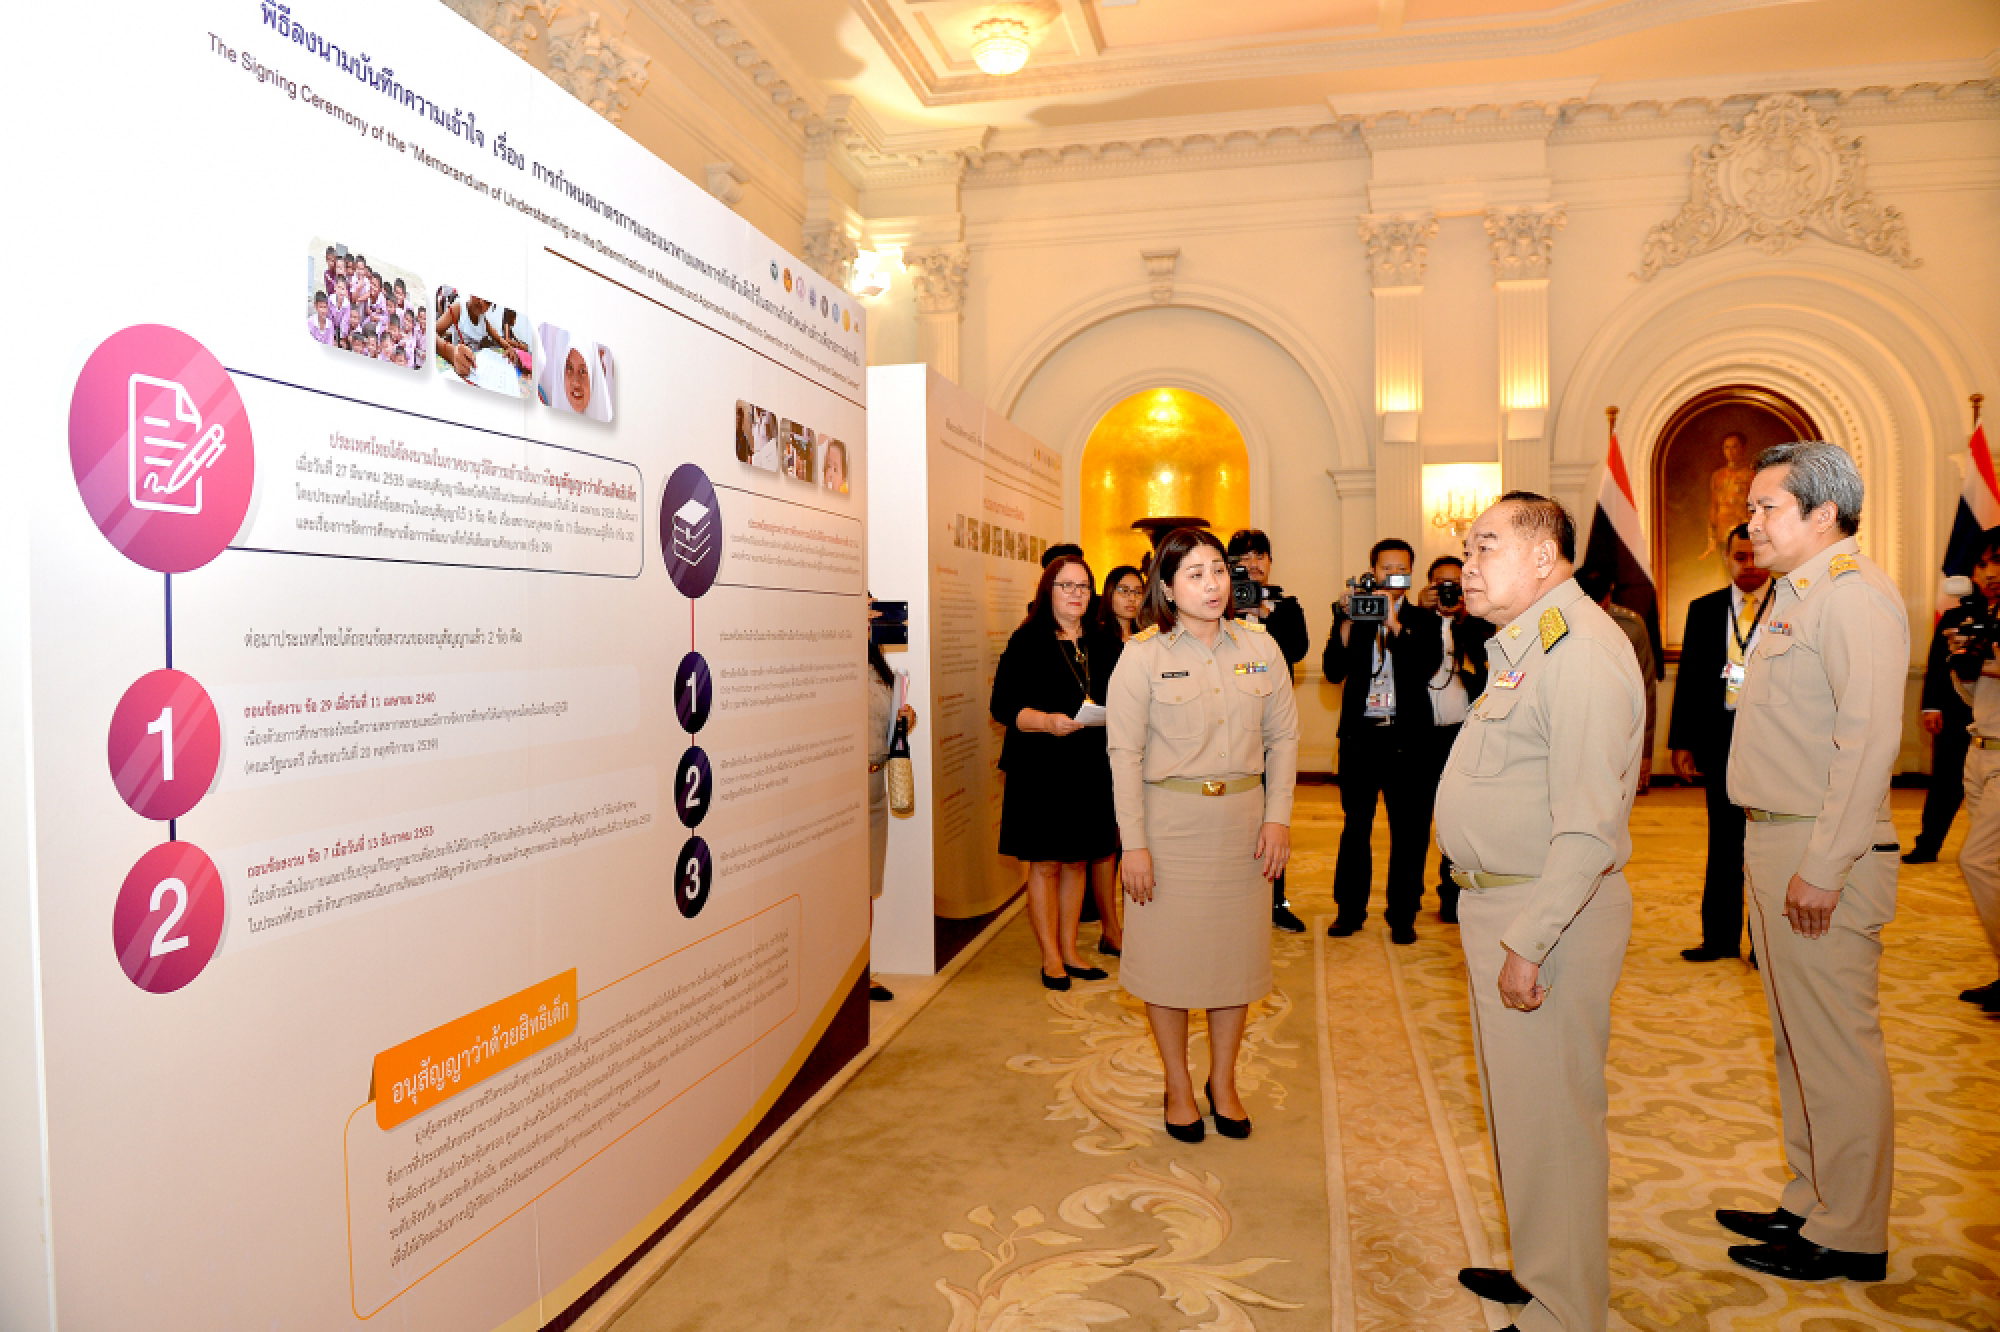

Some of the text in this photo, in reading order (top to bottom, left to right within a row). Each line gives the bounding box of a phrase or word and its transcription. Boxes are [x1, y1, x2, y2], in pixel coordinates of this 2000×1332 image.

[207, 31, 238, 64] The
[241, 51, 297, 101] Signing
[300, 84, 369, 137] Ceremony
[371, 126, 384, 142] of
[386, 131, 406, 154] the
[490, 187, 502, 201] of
[503, 190, 570, 239] Understanding
[335, 464, 347, 478] 27
[304, 697, 318, 713] ข้อ
[320, 699, 332, 712] 29
[686, 671, 697, 713] 1
[147, 707, 174, 780] 1
[686, 765, 700, 809] 2
[307, 848, 320, 864] ข้อ
[685, 857, 700, 900] 3
[149, 877, 189, 958] 2
[391, 994, 569, 1104] อนุสัญญาว่าด้วยสิทธิเด็ก
